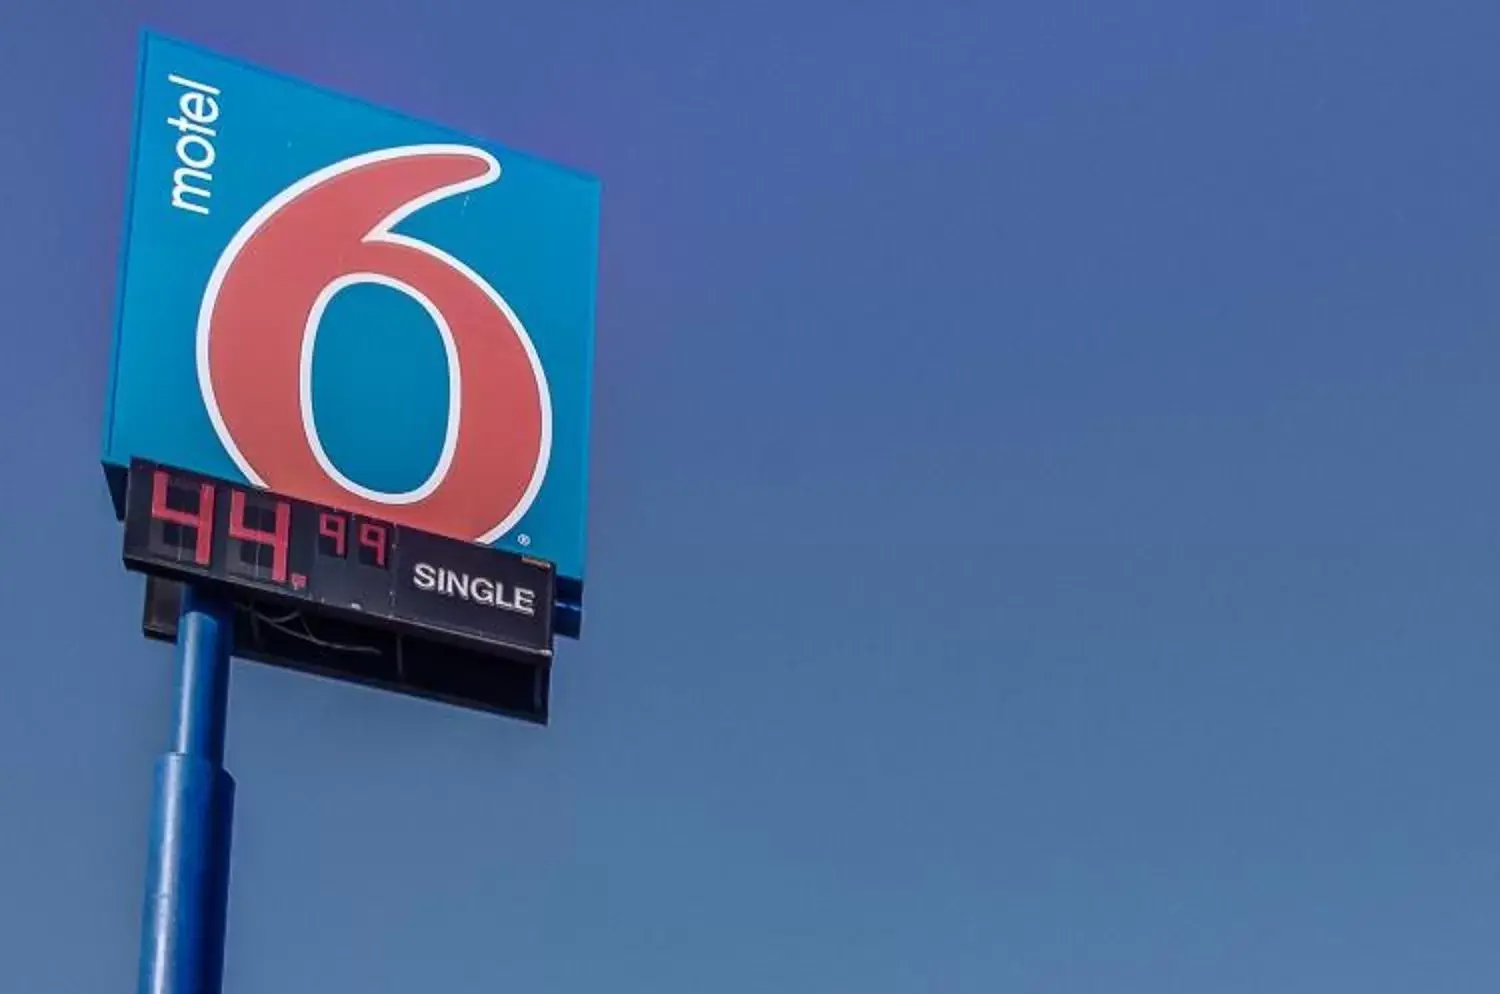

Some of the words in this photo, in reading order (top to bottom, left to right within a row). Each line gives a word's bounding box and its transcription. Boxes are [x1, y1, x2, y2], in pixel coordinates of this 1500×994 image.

[167, 73, 221, 215] motel
[196, 143, 554, 545] 6
[412, 561, 538, 615] SINGLE
